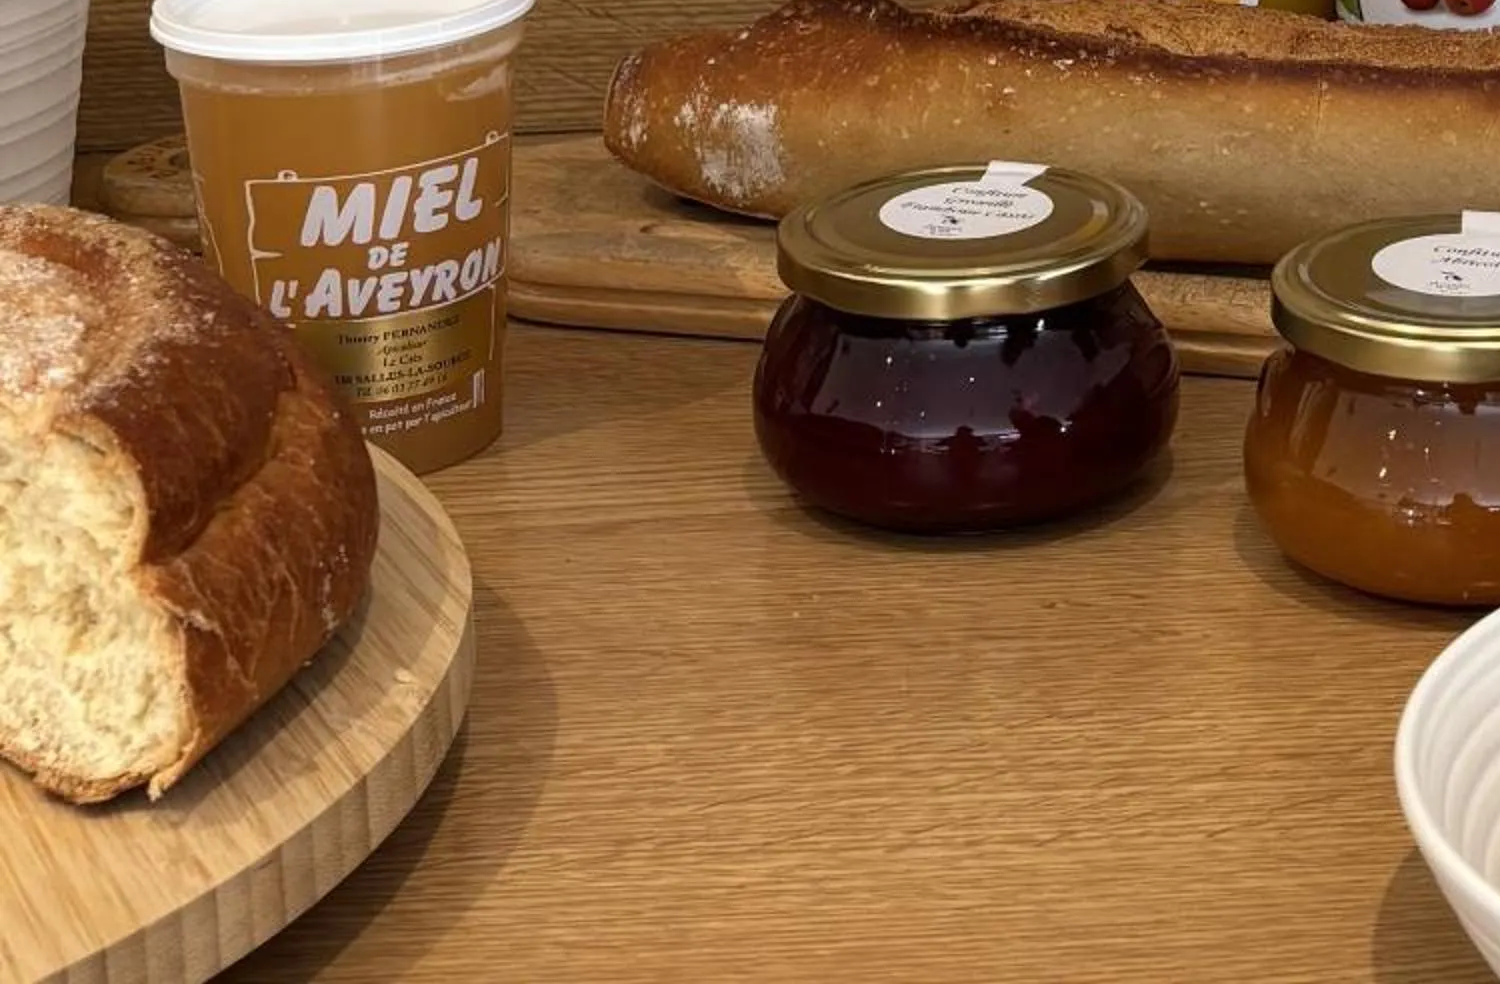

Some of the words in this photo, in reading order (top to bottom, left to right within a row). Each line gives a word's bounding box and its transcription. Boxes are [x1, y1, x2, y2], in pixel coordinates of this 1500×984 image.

[301, 157, 483, 247] MIEL
[269, 236, 502, 318] L'AVEYRON
[368, 241, 410, 270] DE
